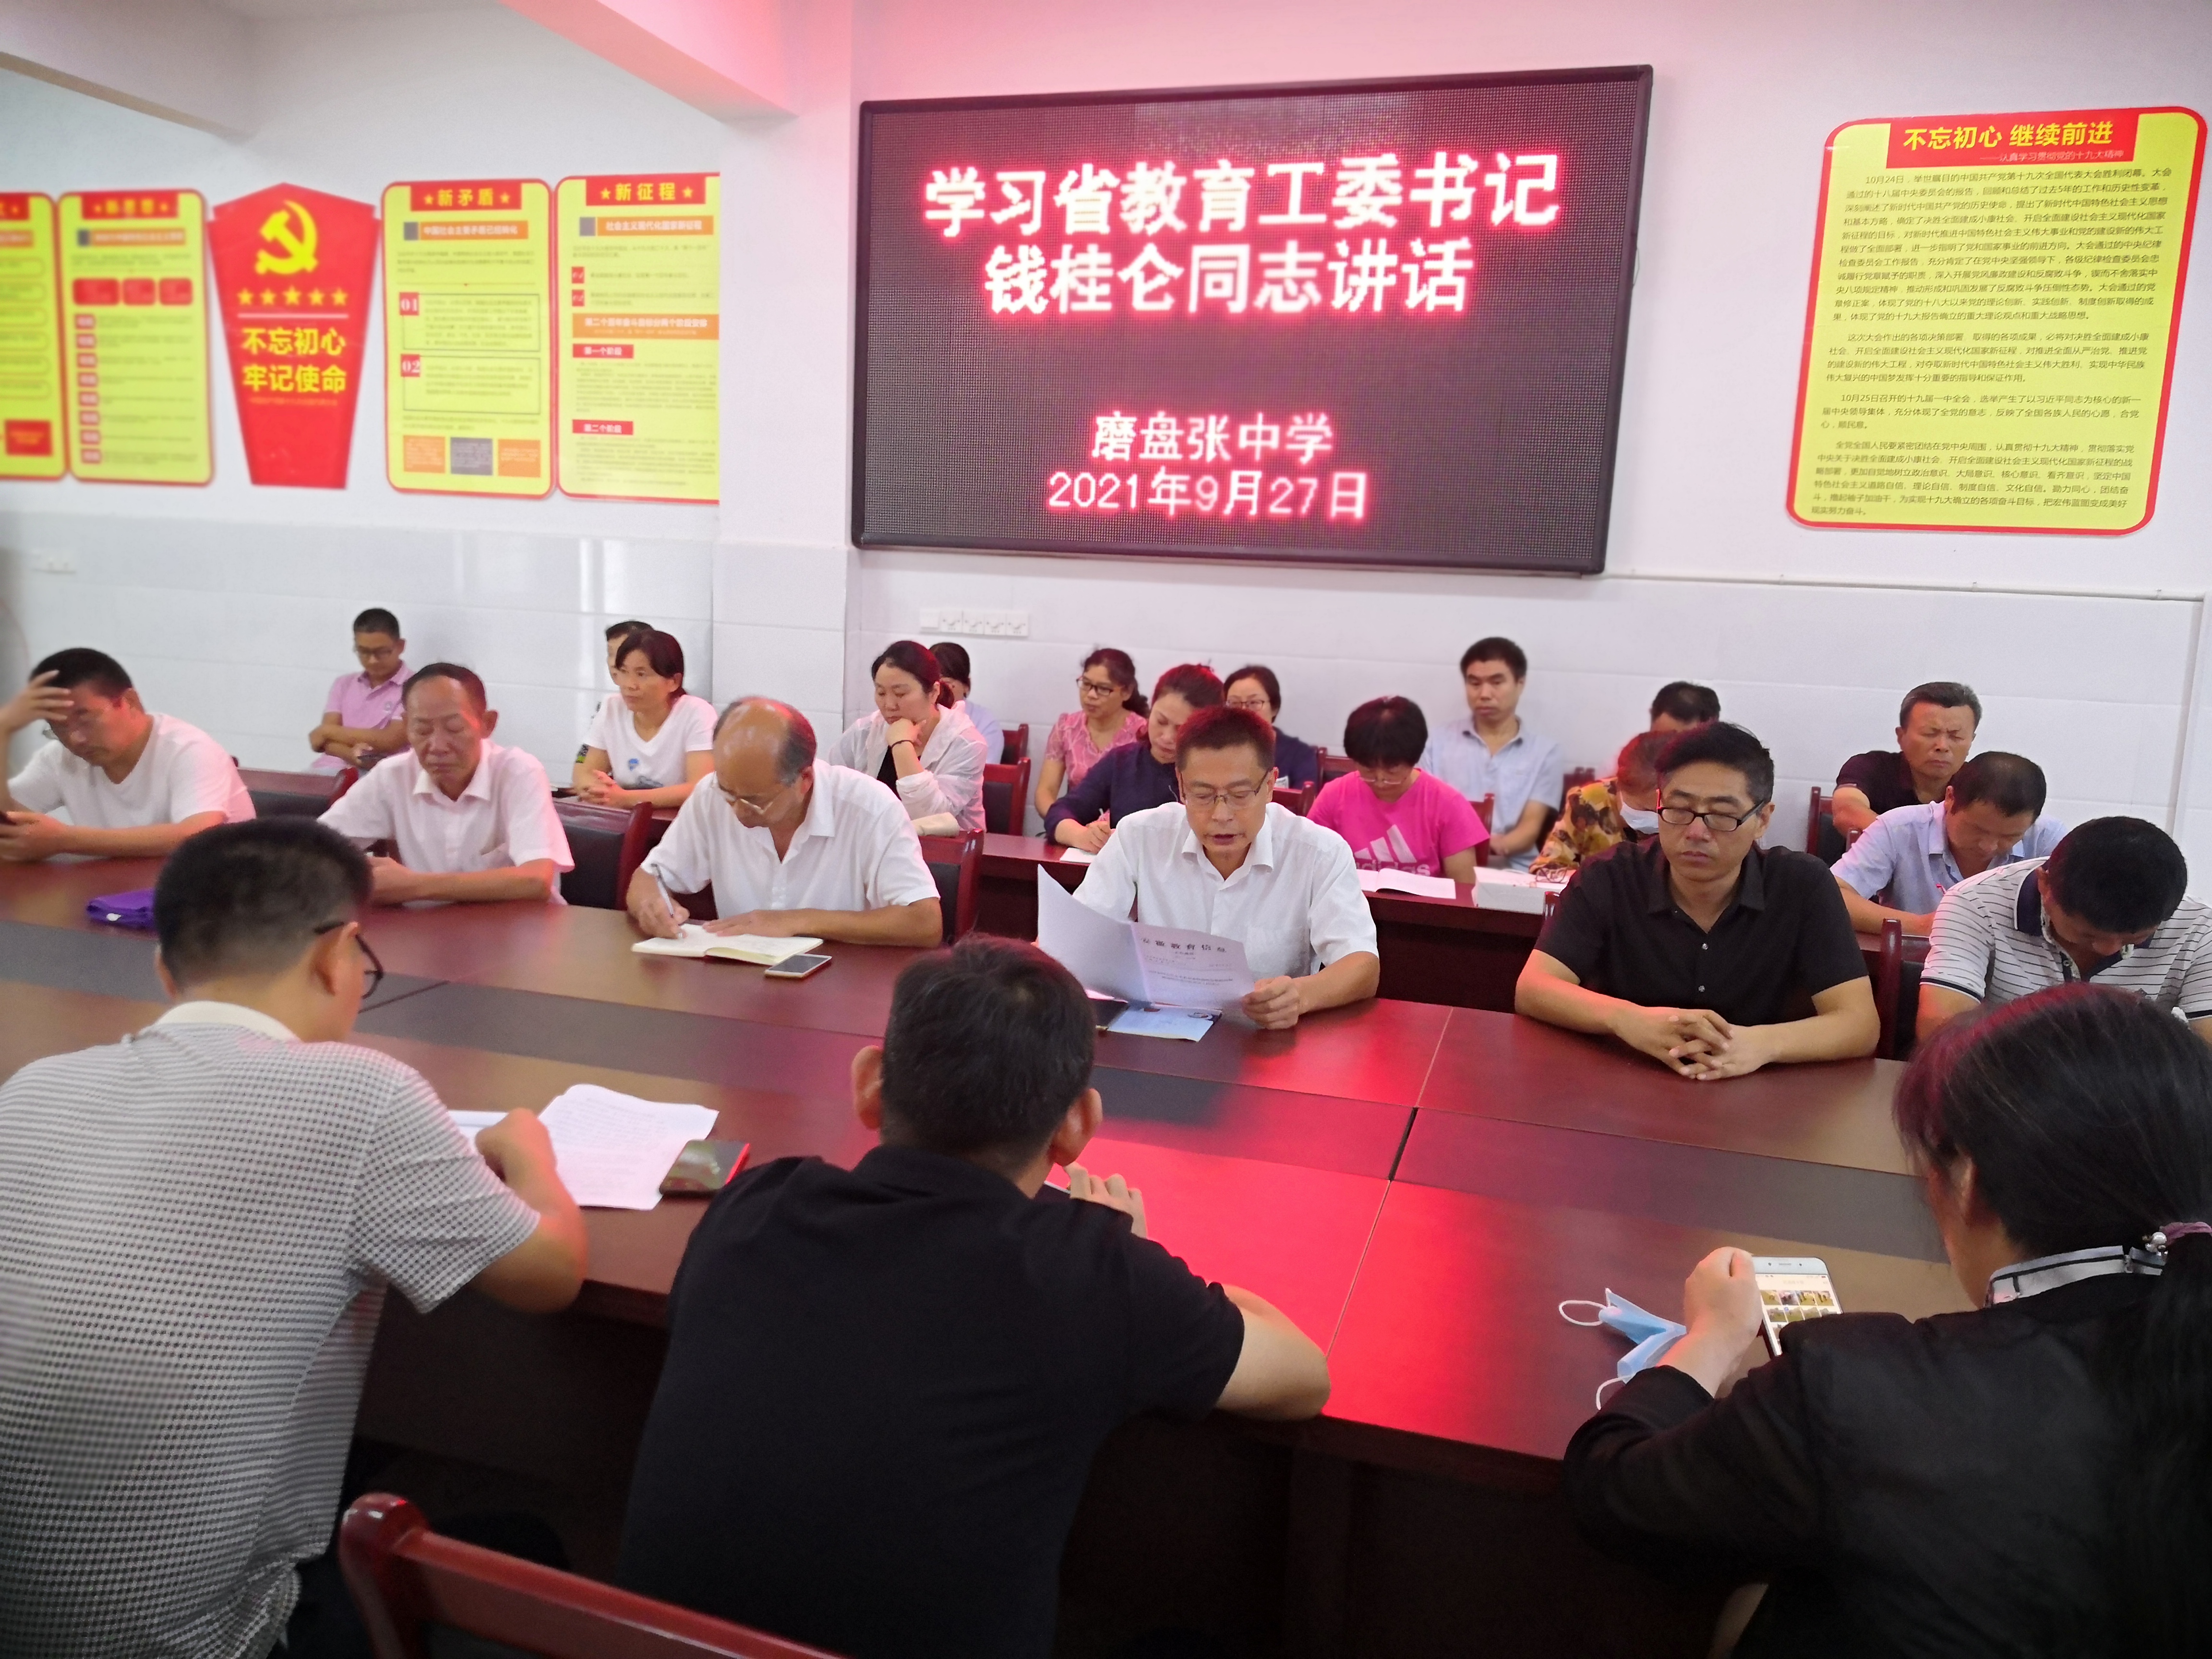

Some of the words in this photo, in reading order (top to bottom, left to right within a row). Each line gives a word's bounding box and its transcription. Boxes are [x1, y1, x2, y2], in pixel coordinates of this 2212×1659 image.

[1903, 125, 2002, 150] 不忘初心
[2009, 121, 2113, 146] 继续前进
[438, 188, 493, 206] 新矛盾
[616, 182, 675, 201] 新征程
[925, 151, 1559, 236] 学习省教育工委书记
[985, 238, 1474, 315] 钱桂仑同志讲话
[401, 299, 418, 312] 01
[242, 327, 346, 356] 不忘初心
[242, 364, 347, 393] 牢记使命
[402, 361, 420, 373] 02
[1092, 410, 1333, 465] 磨盘张中学
[1049, 467, 1367, 519] 2021年9月27日
